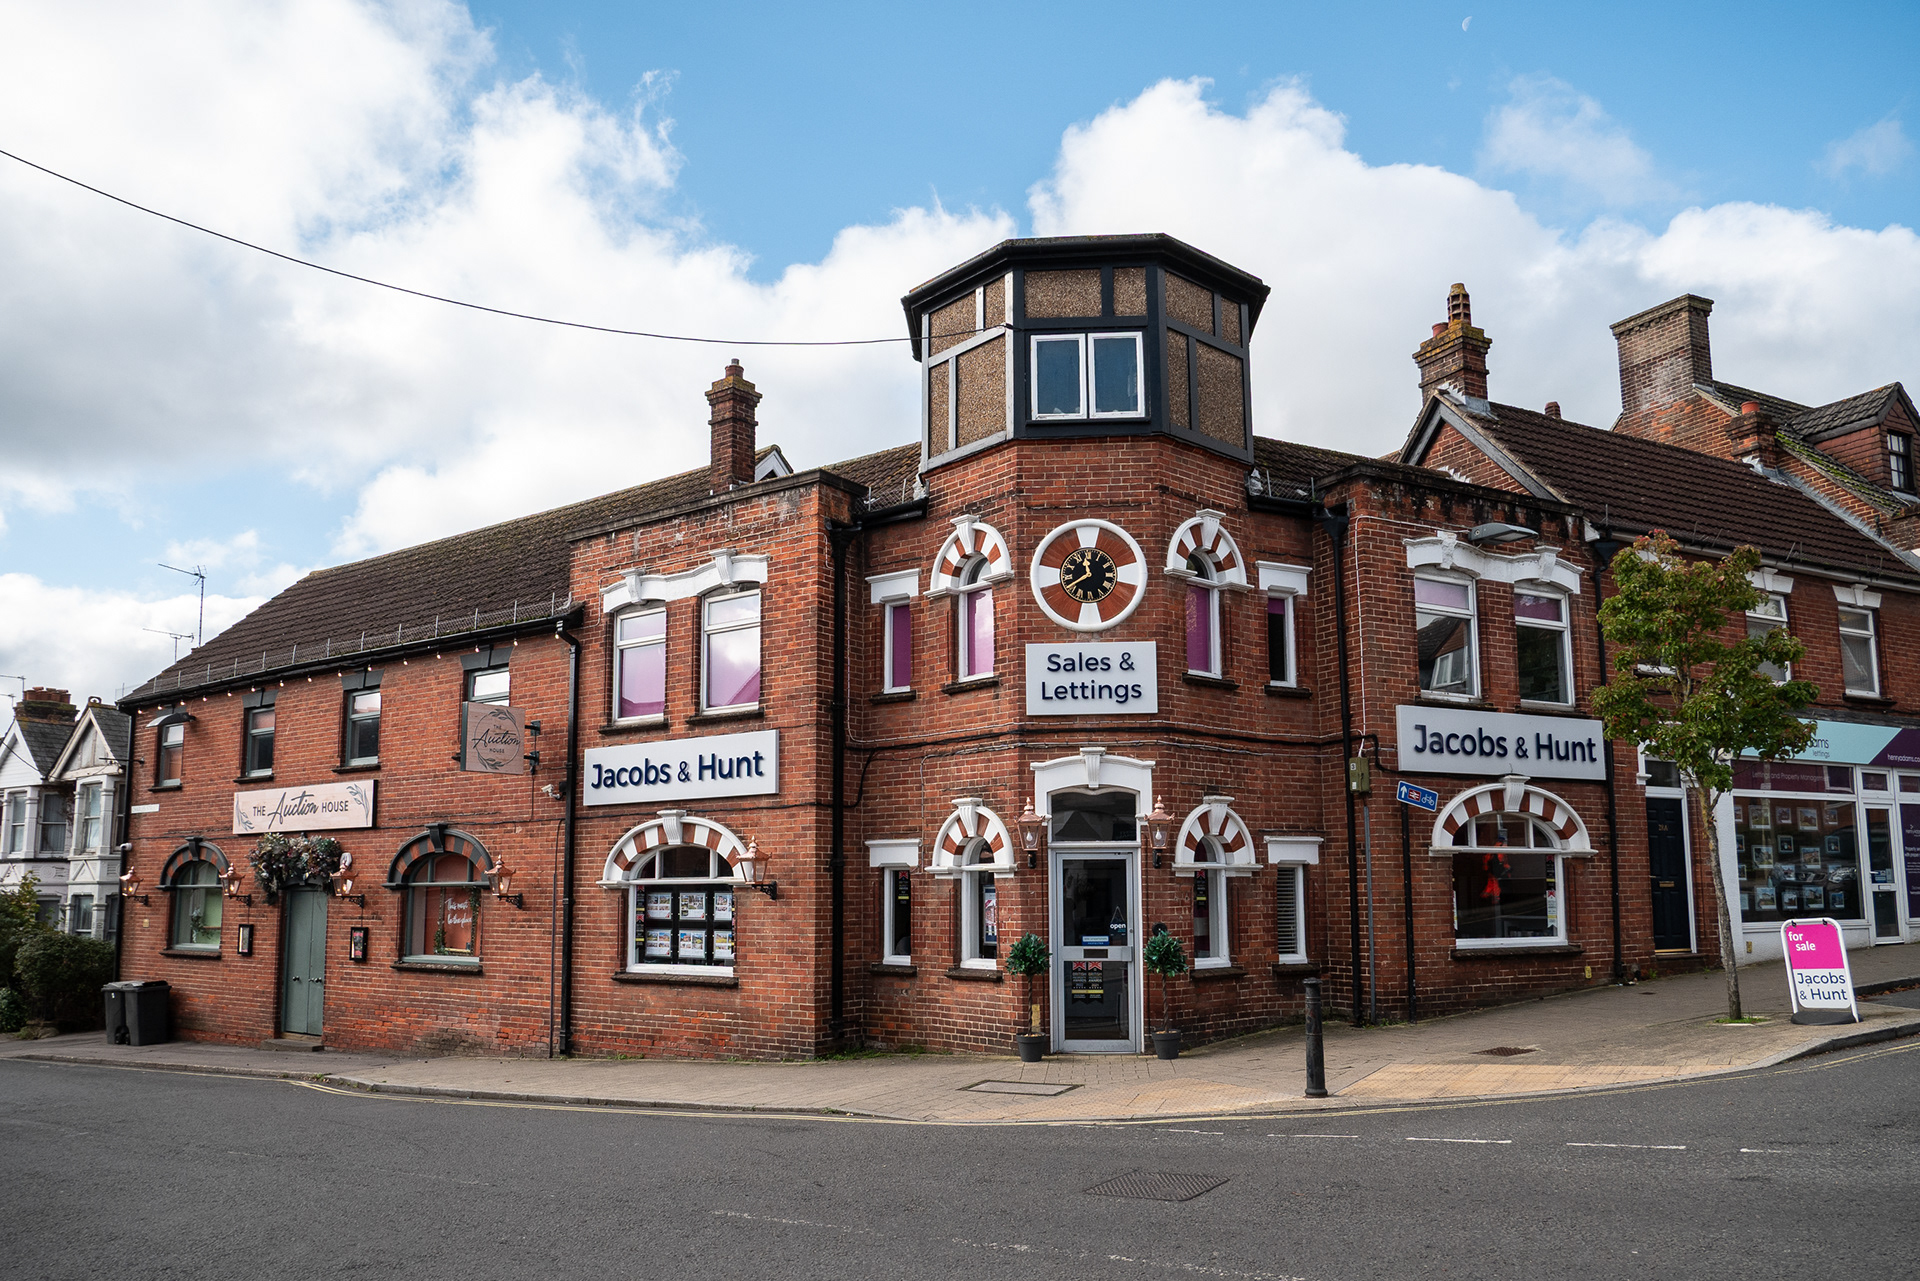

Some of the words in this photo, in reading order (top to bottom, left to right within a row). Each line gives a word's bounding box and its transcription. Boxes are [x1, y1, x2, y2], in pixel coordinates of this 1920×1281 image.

[1046, 652, 1111, 672] Sales
[1119, 652, 1135, 671] &
[1042, 680, 1142, 704] Lettings
[472, 728, 520, 749] Auction
[1414, 724, 1508, 758] Jacobs
[1515, 736, 1529, 759] &
[1536, 732, 1597, 763] Hunt
[591, 758, 671, 789] Jacobs
[677, 760, 691, 782] &
[698, 750, 764, 781] Hunt
[1781, 772, 1800, 780] Property
[253, 806, 266, 816] THE
[267, 790, 320, 829] Auction
[322, 800, 349, 812] HOUSE
[1788, 932, 1803, 941] for
[1796, 941, 1816, 951] sale
[1797, 972, 1846, 984] Jacobs
[1800, 990, 1807, 1000] &
[1810, 988, 1847, 1000] Hunt
